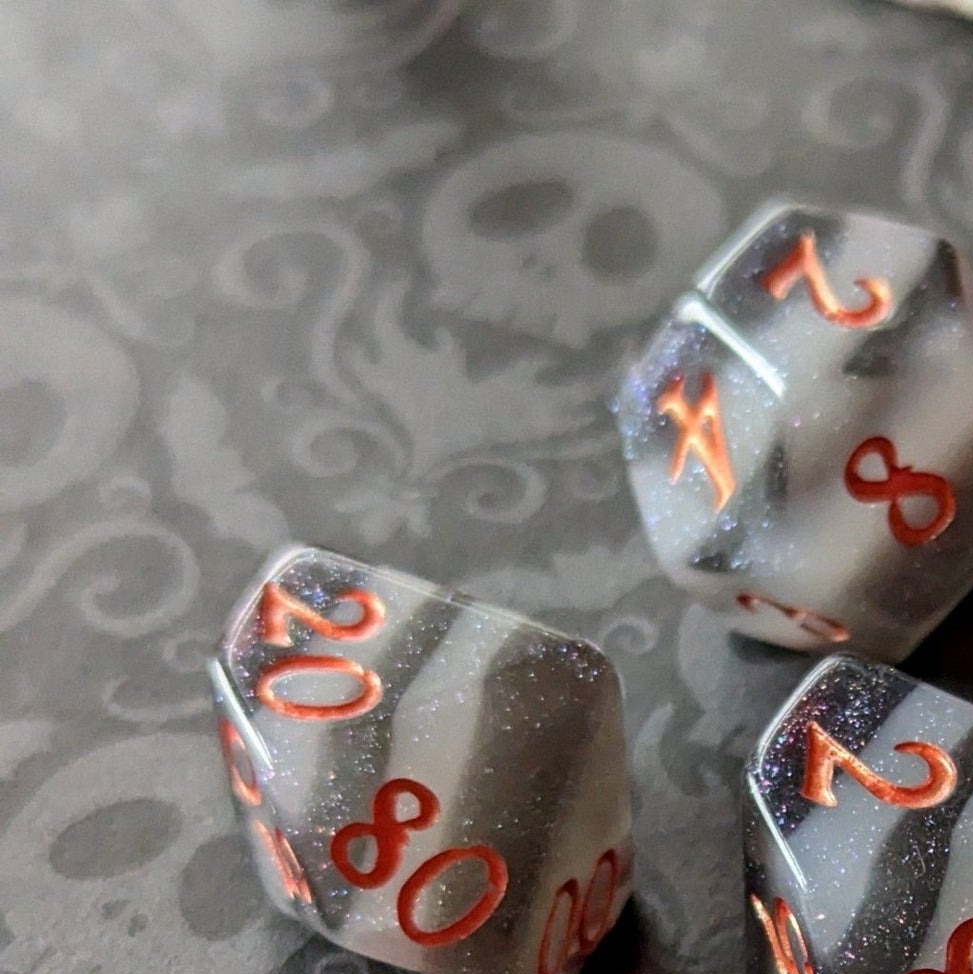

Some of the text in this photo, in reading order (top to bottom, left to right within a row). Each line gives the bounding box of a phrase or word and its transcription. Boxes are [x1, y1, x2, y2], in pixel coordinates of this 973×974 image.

[760, 234, 893, 329] 2
[657, 372, 736, 510] 4
[842, 435, 958, 548] 8
[254, 581, 387, 722] 20
[799, 718, 958, 810] 2
[329, 777, 509, 948] 80
